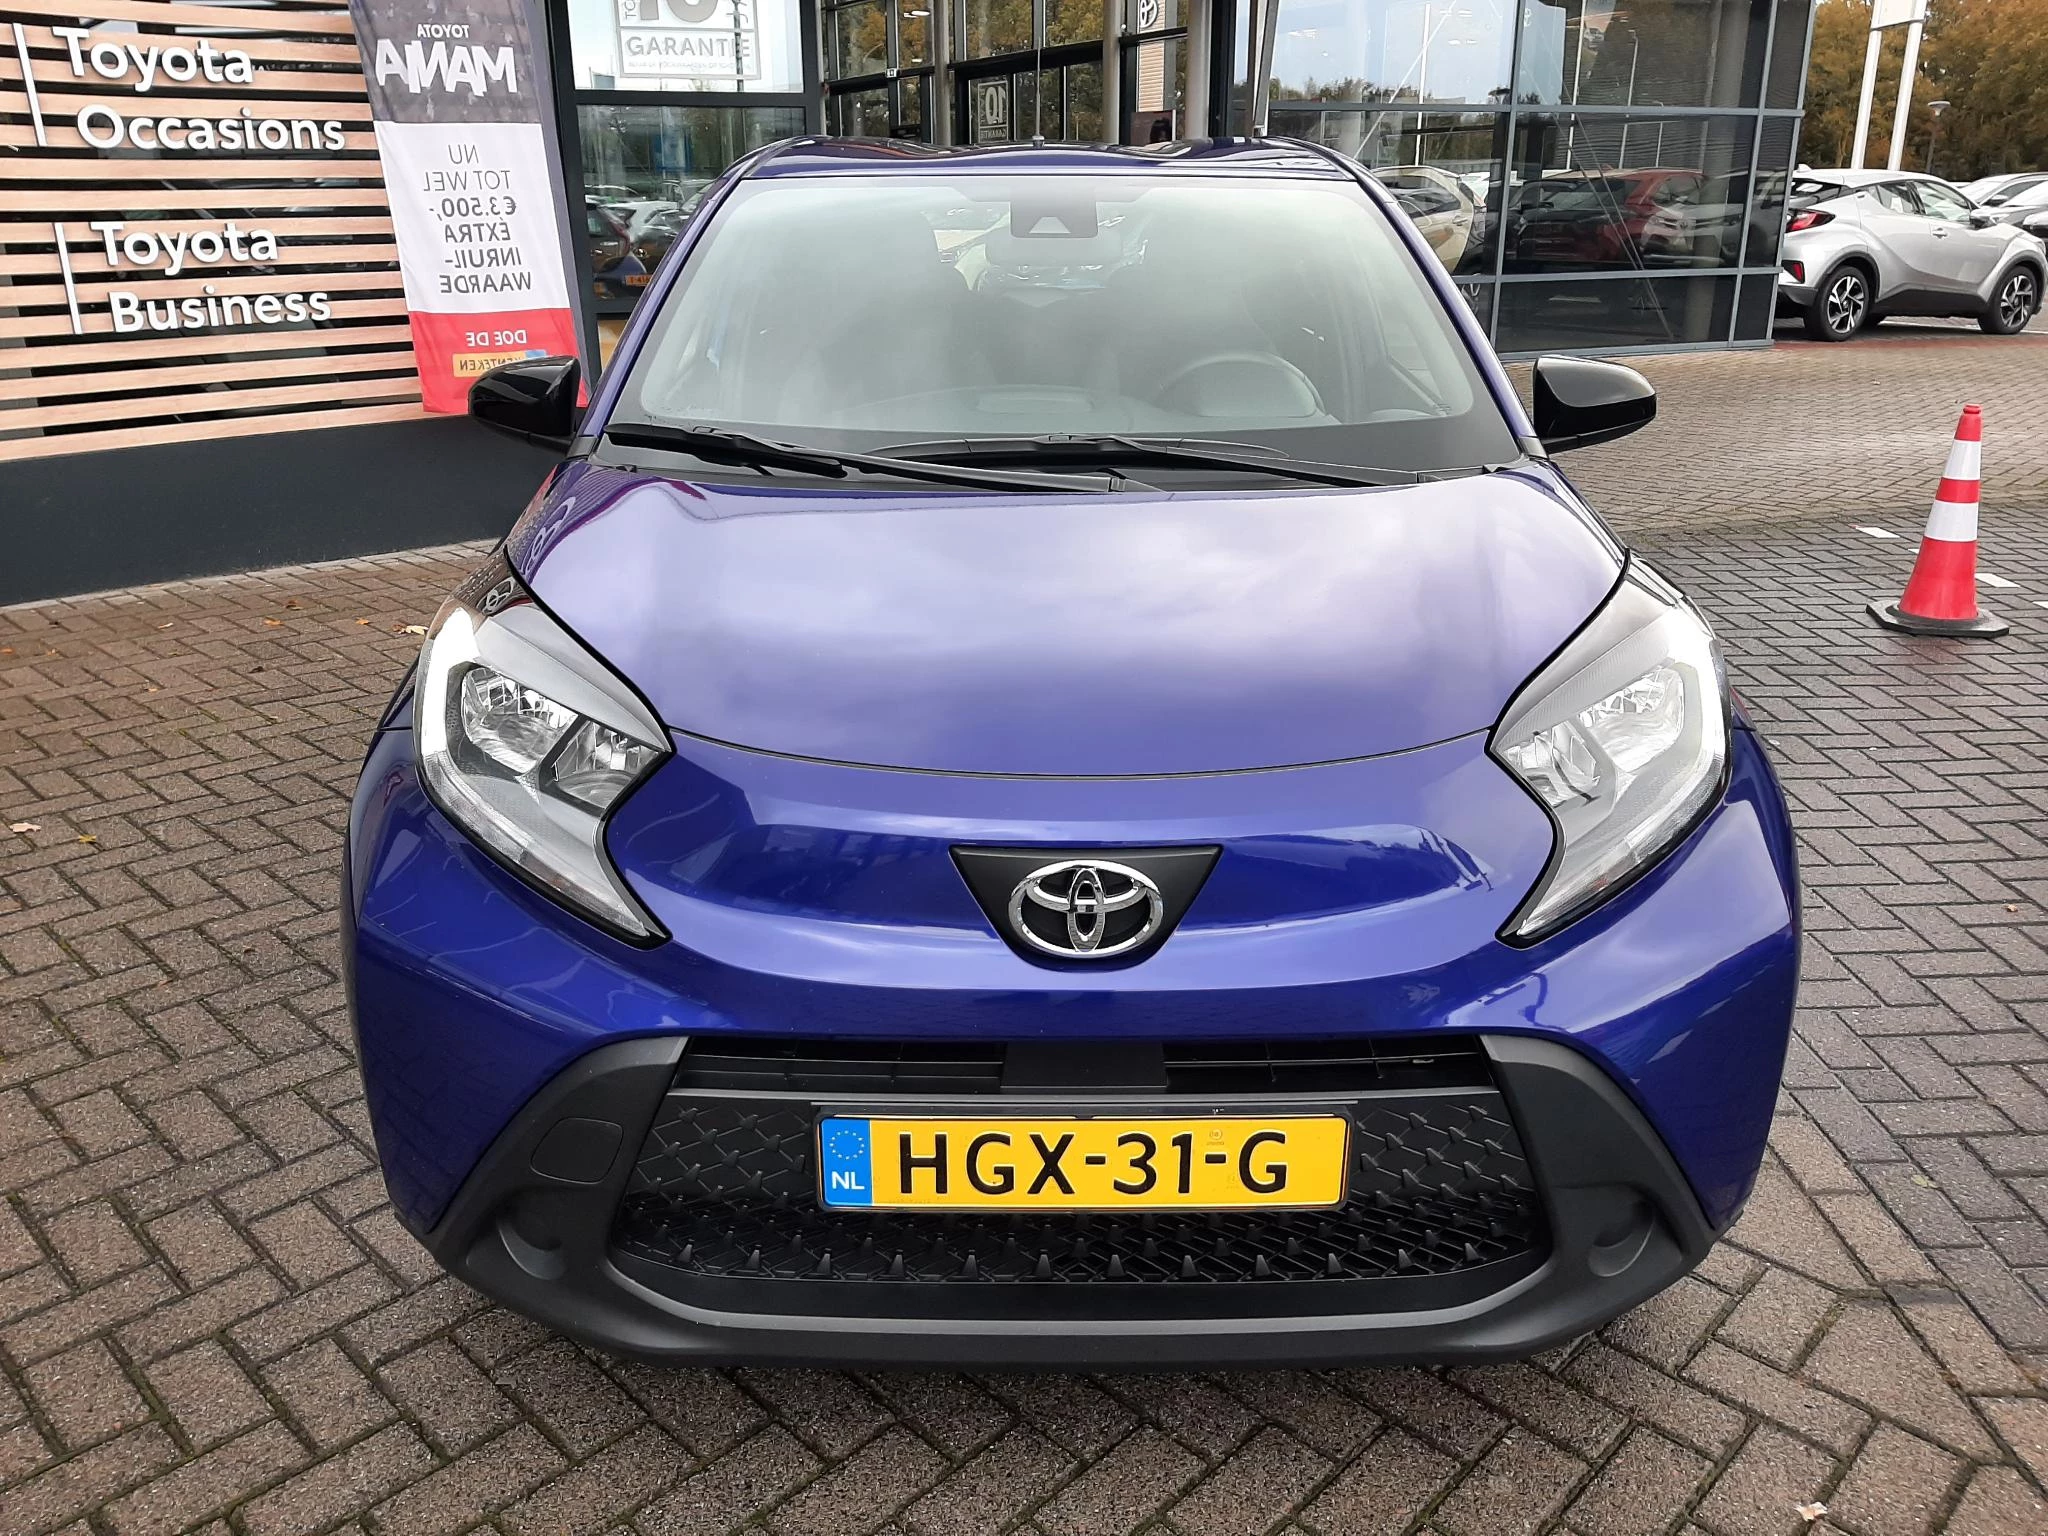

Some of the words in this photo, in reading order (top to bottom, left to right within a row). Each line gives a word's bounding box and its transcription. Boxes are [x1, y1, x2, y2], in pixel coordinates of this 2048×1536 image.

[52, 26, 253, 92] Toyota
[626, 36, 750, 57] GARANTIE
[77, 104, 346, 150] Occasions
[90, 221, 279, 276] Toyota
[107, 285, 332, 334] Business
[831, 1170, 865, 1191] NL
[899, 1131, 1288, 1196] HGX-31-G
